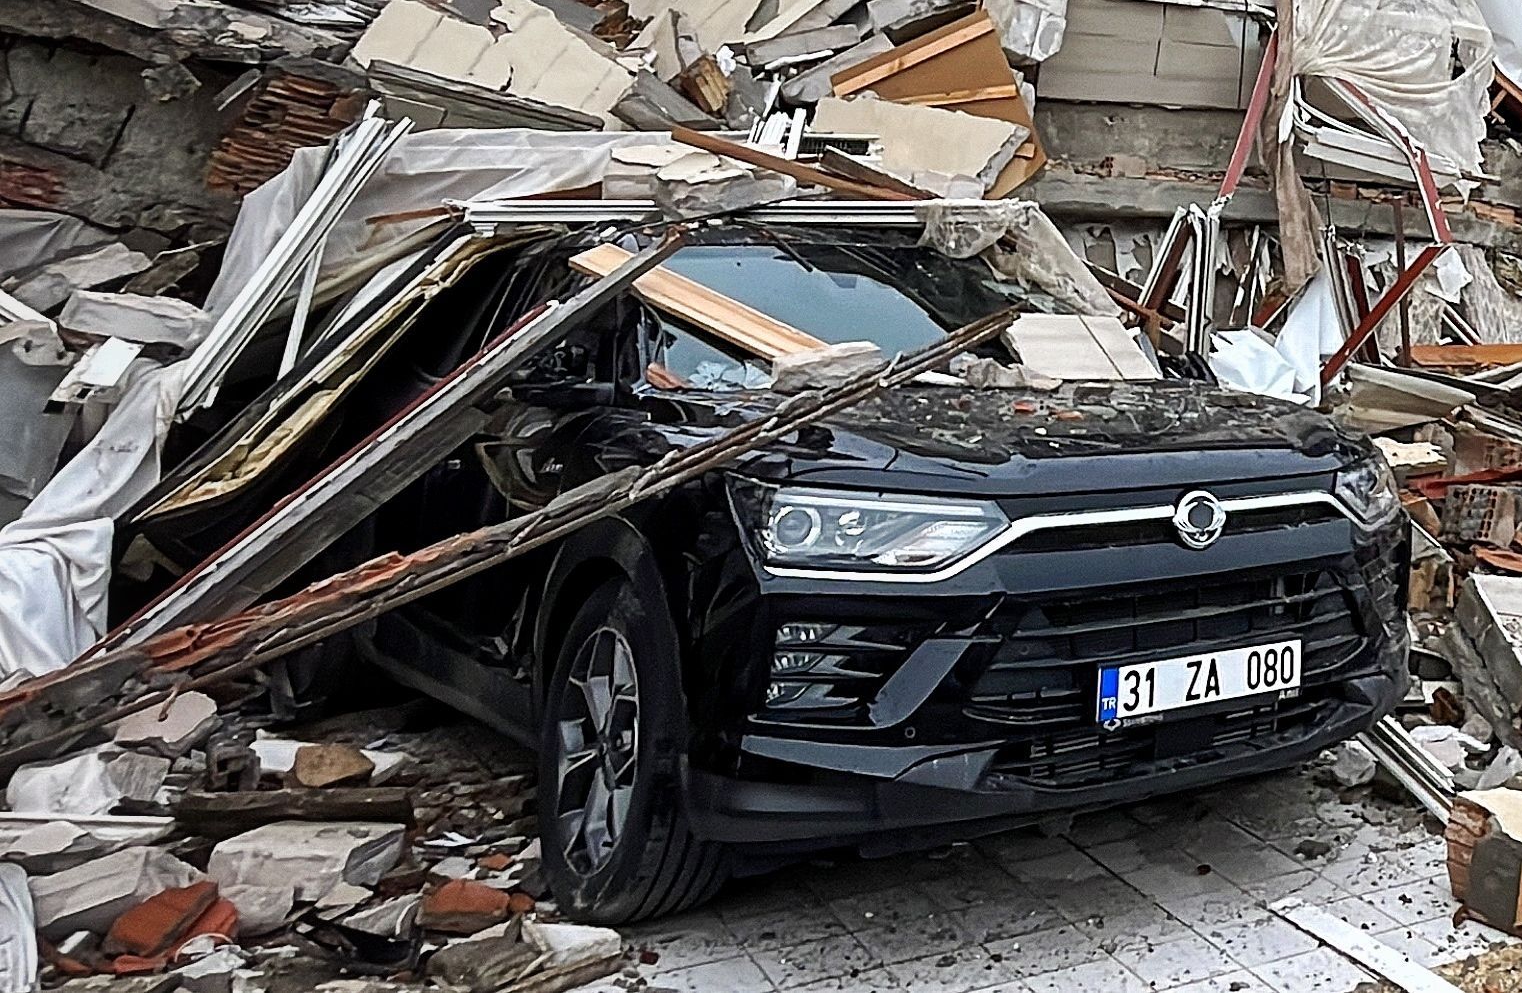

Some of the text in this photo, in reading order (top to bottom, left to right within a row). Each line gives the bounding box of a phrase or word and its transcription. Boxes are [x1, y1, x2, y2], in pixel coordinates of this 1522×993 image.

[1123, 645, 1294, 712] 31 ZA 080
[1101, 696, 1117, 711] TR
